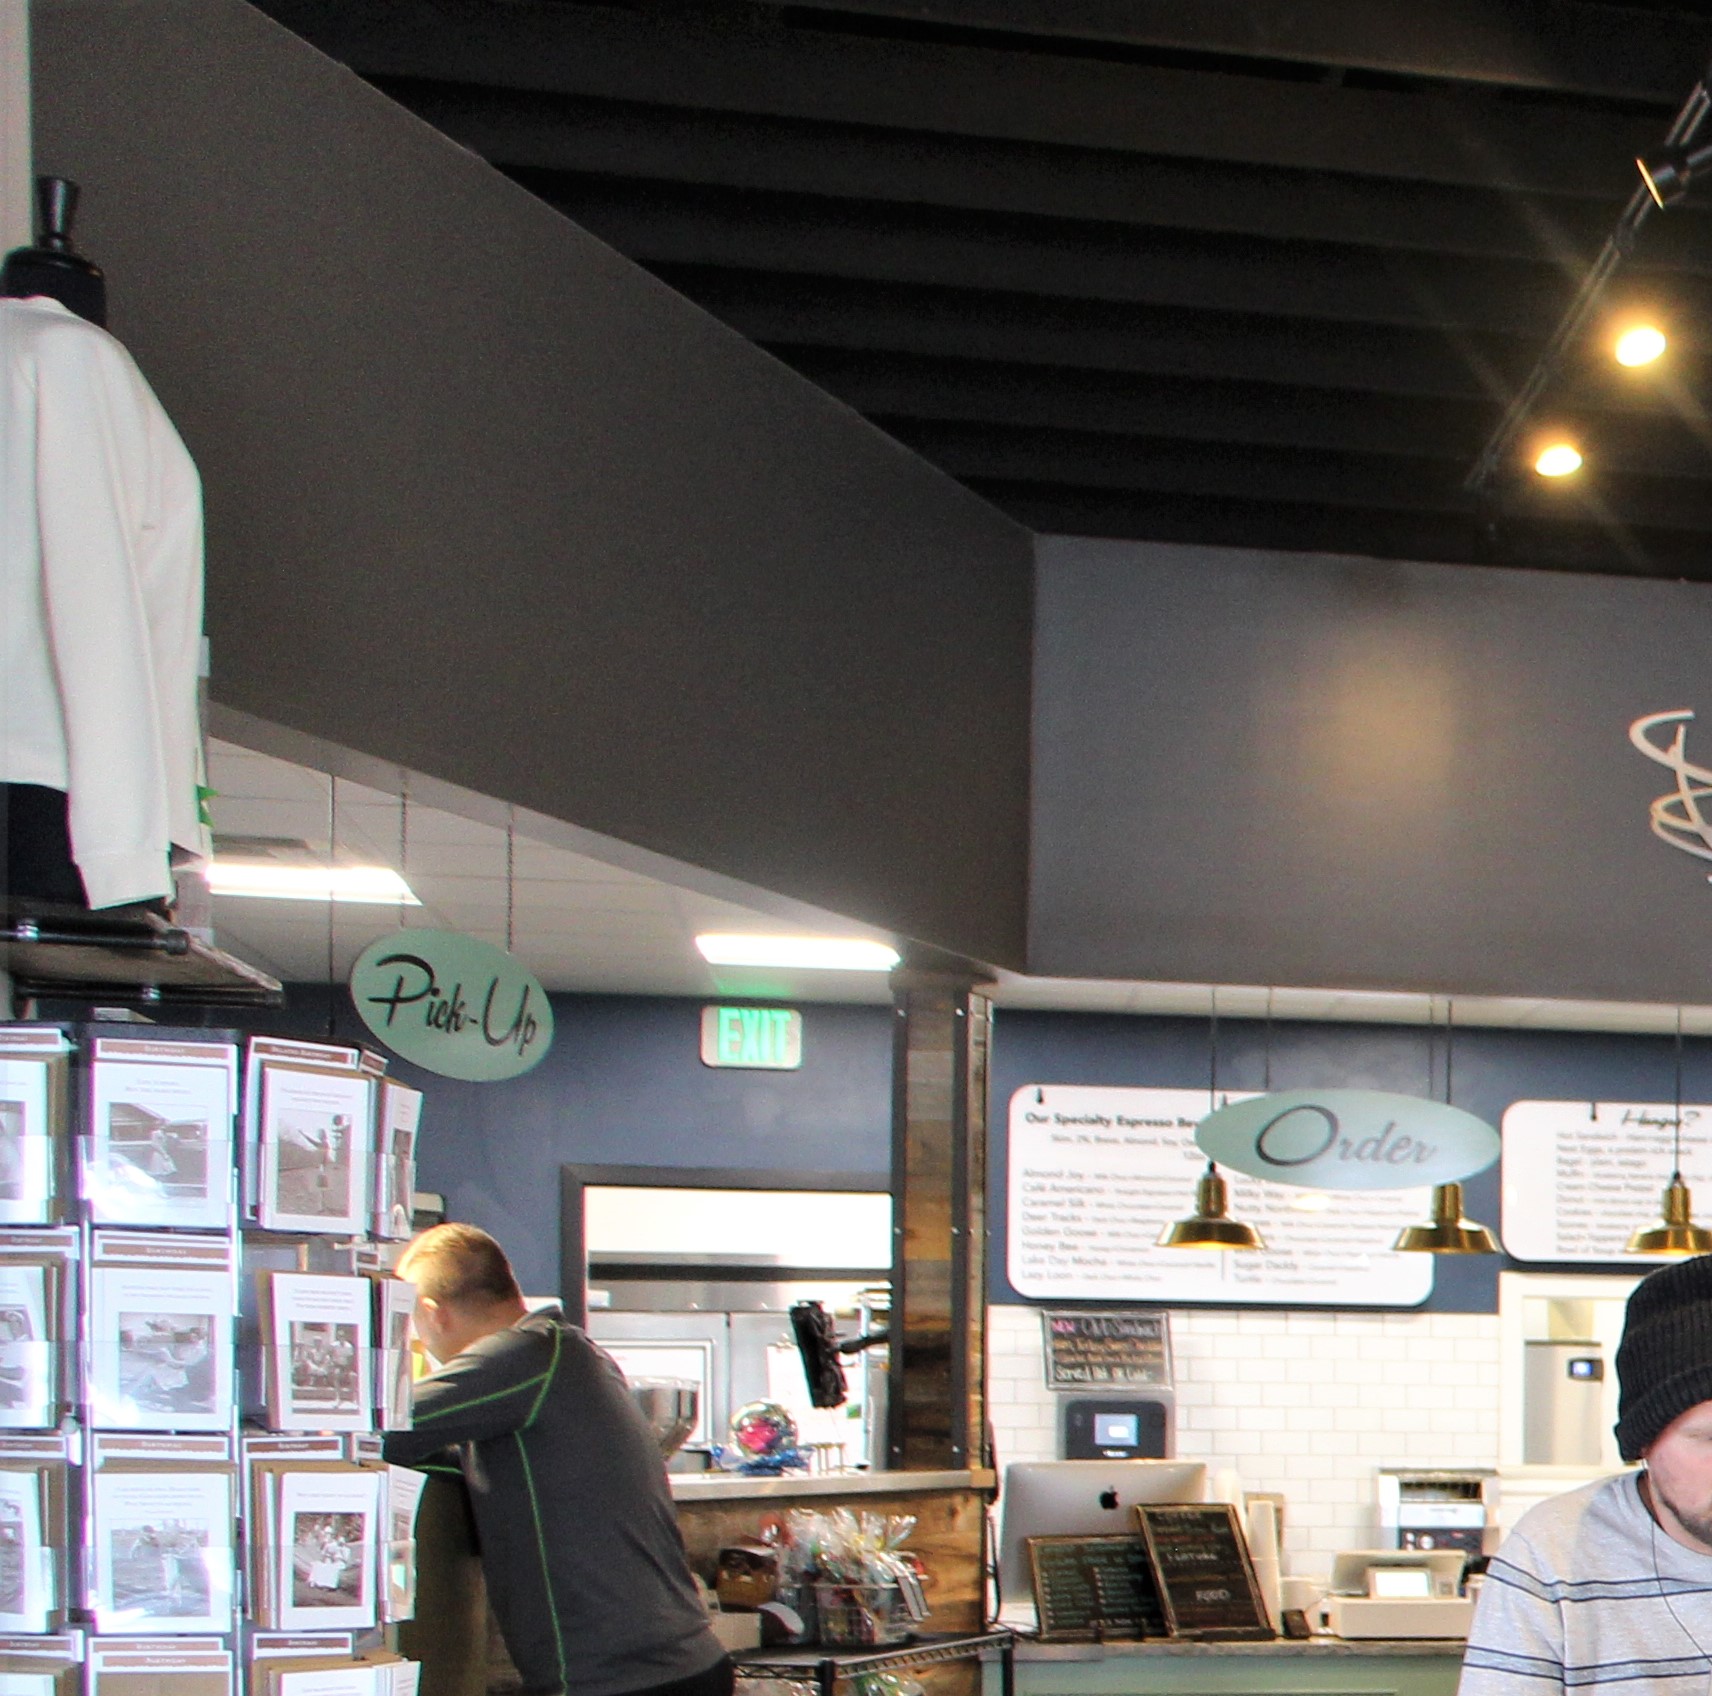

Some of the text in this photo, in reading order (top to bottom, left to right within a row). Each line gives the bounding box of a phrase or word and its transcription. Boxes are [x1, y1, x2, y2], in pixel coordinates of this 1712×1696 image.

[368, 954, 537, 1056] Pick-Up
[718, 1007, 792, 1062] EXIT
[1025, 1112, 1048, 1124] Our
[1054, 1113, 1111, 1128] Specialty
[1116, 1115, 1173, 1129] Espresso
[1255, 1104, 1436, 1166] Order
